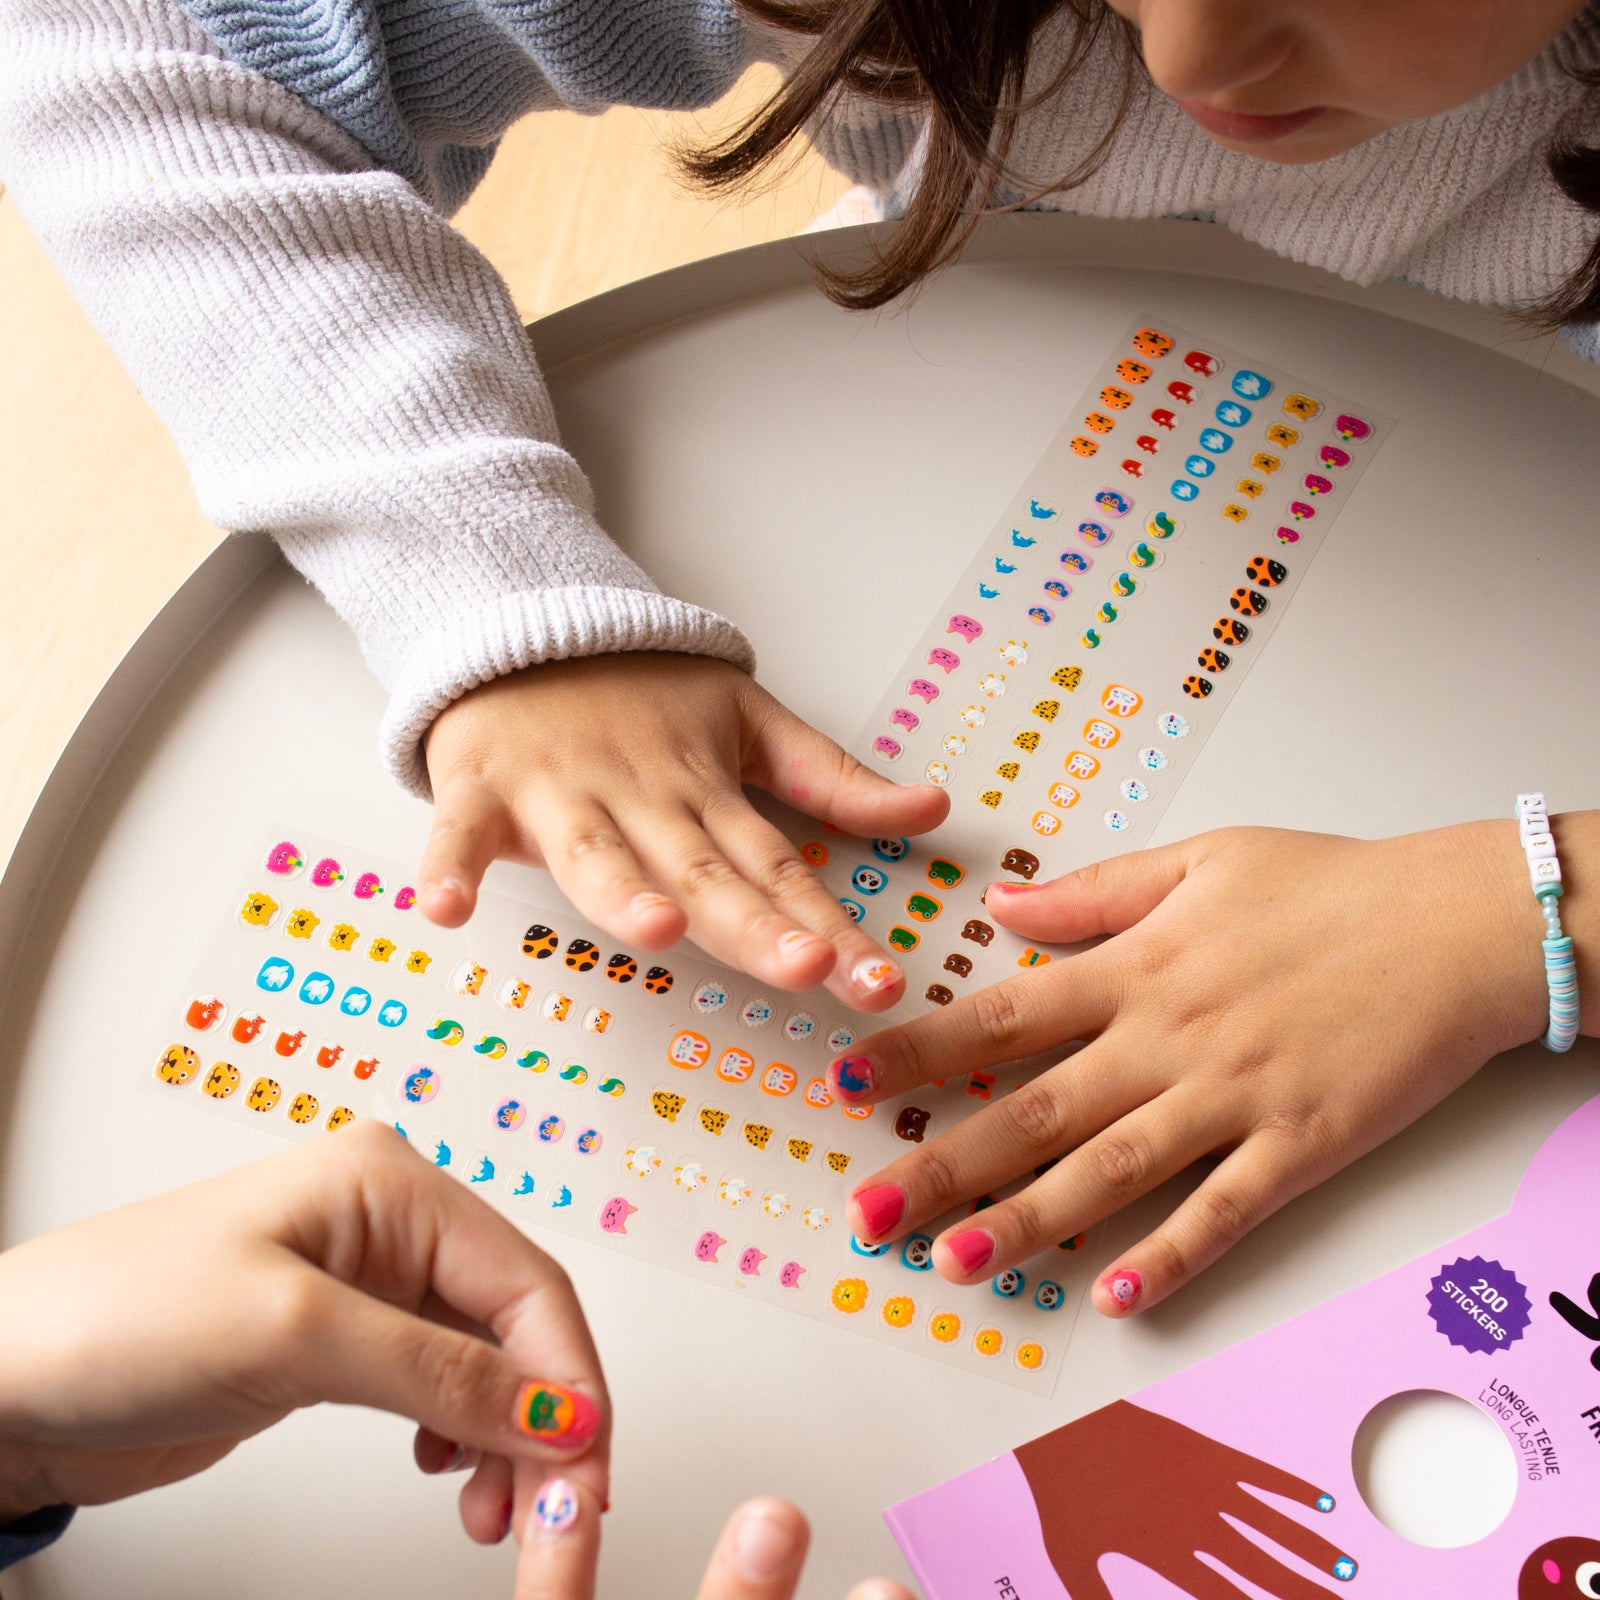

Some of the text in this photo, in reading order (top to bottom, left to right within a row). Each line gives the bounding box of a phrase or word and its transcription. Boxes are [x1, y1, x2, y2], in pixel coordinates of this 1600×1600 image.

[1441, 1280, 1507, 1341] STICKERS
[1469, 1278, 1509, 1313] 200
[1478, 1389, 1542, 1481] LONG LASTING
[1489, 1378, 1560, 1475] LONGUE TENUE
